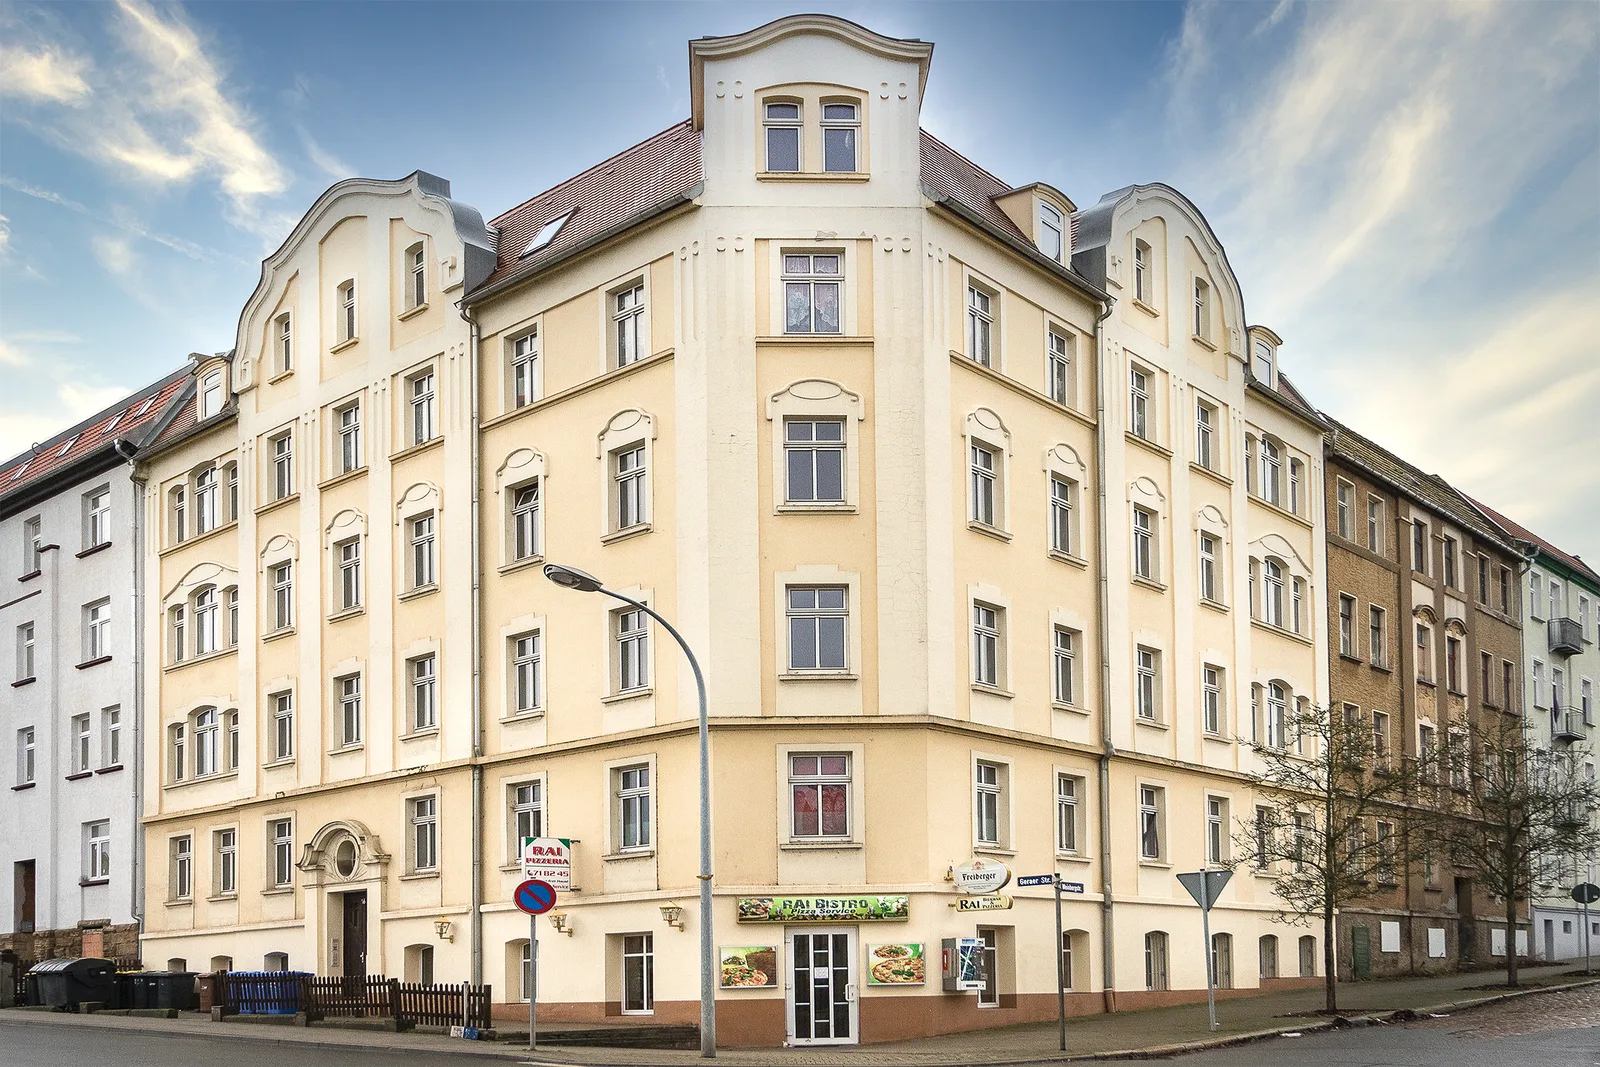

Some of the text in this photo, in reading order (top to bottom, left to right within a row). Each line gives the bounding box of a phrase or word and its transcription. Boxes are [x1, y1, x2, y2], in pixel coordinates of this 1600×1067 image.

[533, 846, 562, 856] RAI
[961, 873, 996, 881] Freiberger
[782, 899, 868, 909] RAI BISTRO
[960, 900, 980, 909] RAI
